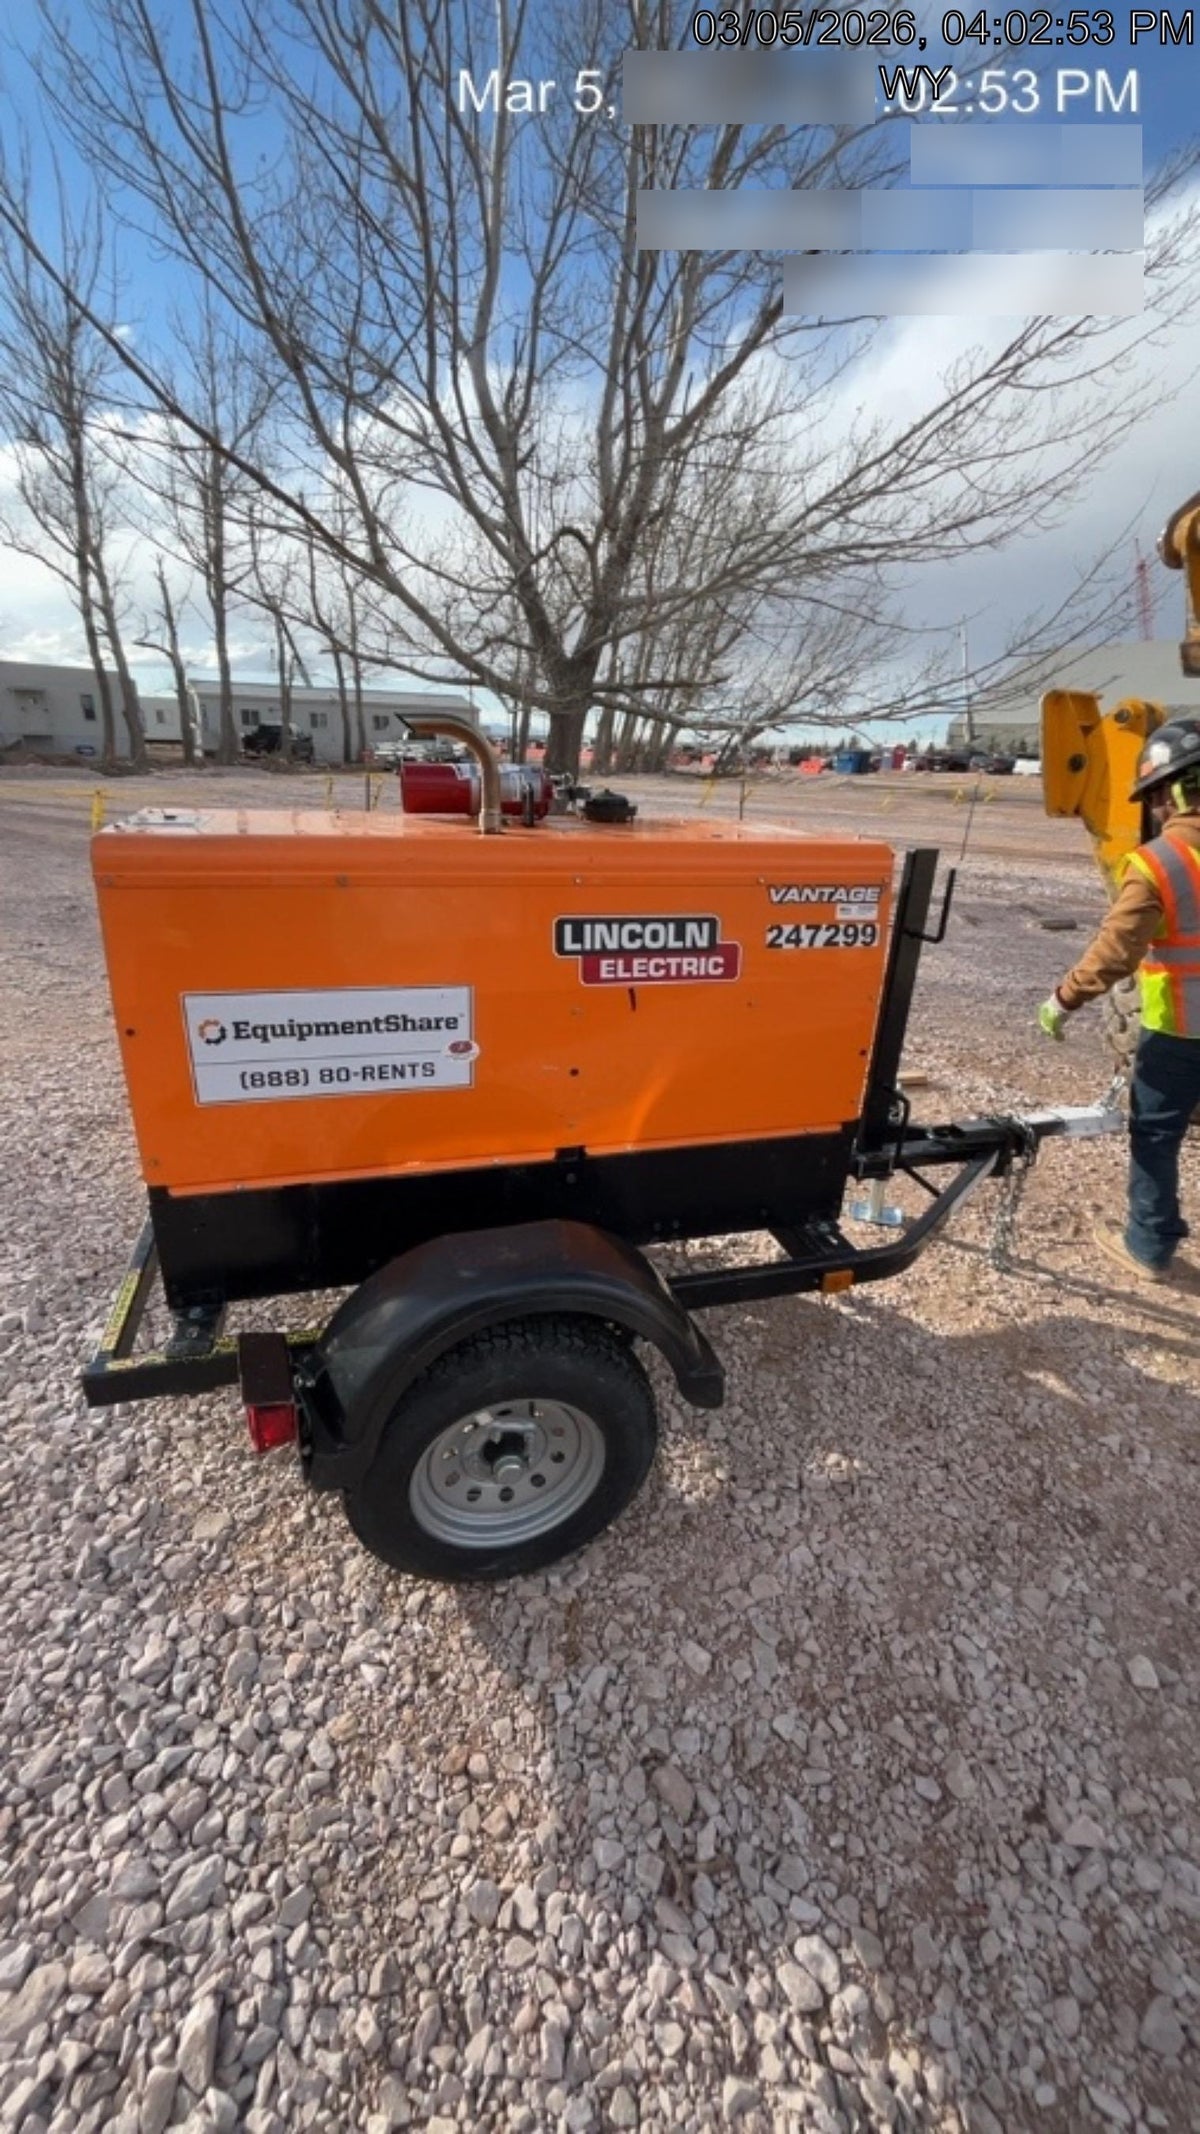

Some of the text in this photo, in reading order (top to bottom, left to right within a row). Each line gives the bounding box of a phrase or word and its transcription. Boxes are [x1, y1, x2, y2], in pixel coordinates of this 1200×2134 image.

[768, 886, 882, 903] VANTAGE
[562, 921, 710, 950] LINCOLN
[766, 924, 877, 948] 247299
[600, 956, 725, 980] ELECTRIC
[232, 1014, 460, 1043] EquipmentShare
[240, 1062, 436, 1090] (888) 80-RENTS
